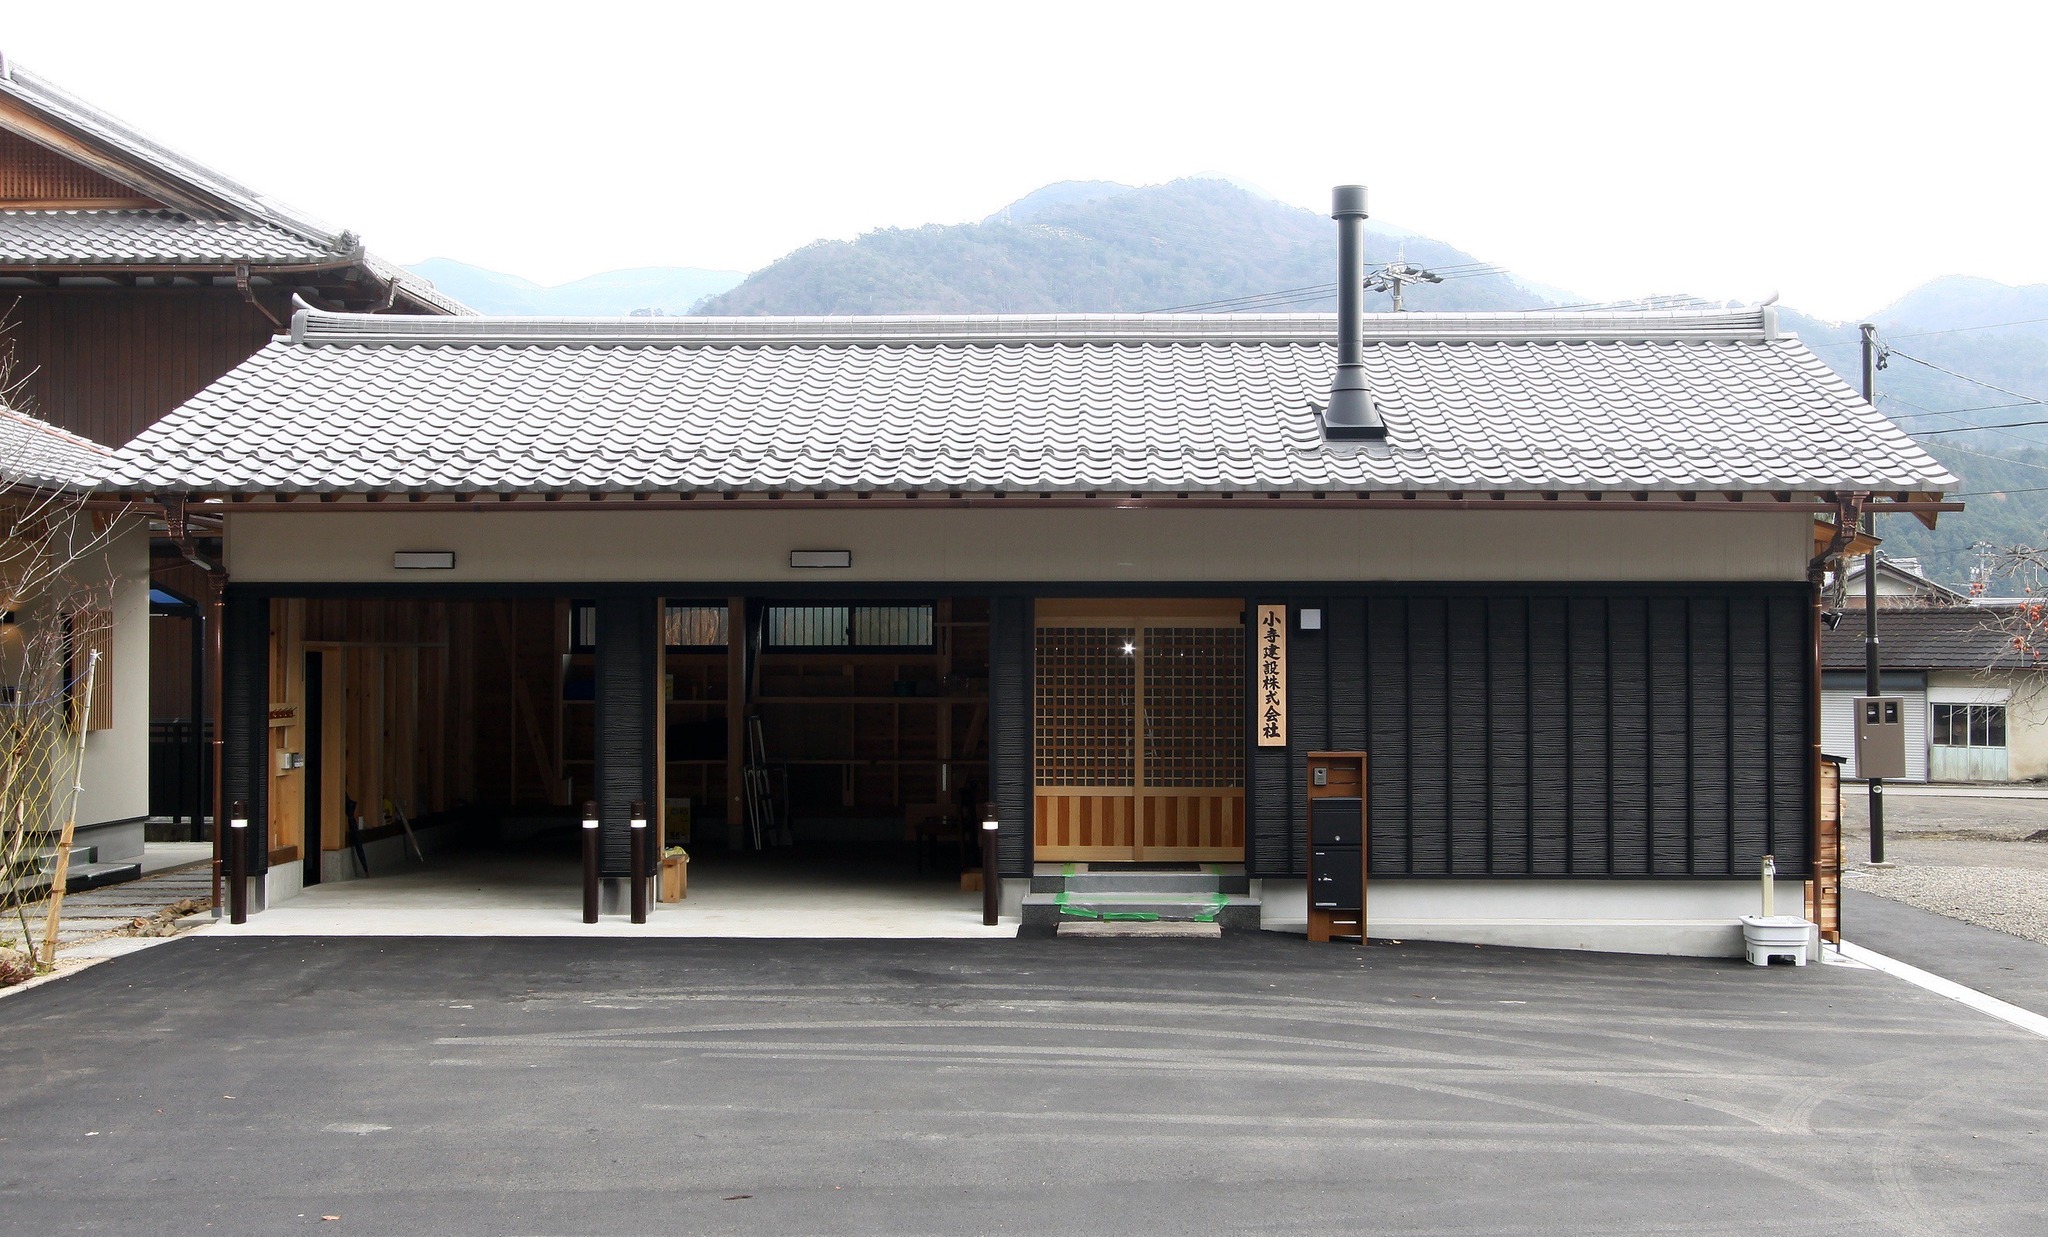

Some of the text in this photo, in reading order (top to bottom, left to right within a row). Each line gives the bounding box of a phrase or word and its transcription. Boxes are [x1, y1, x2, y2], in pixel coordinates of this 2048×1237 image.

[1262, 610, 1282, 739] 小寺建設株式会社
